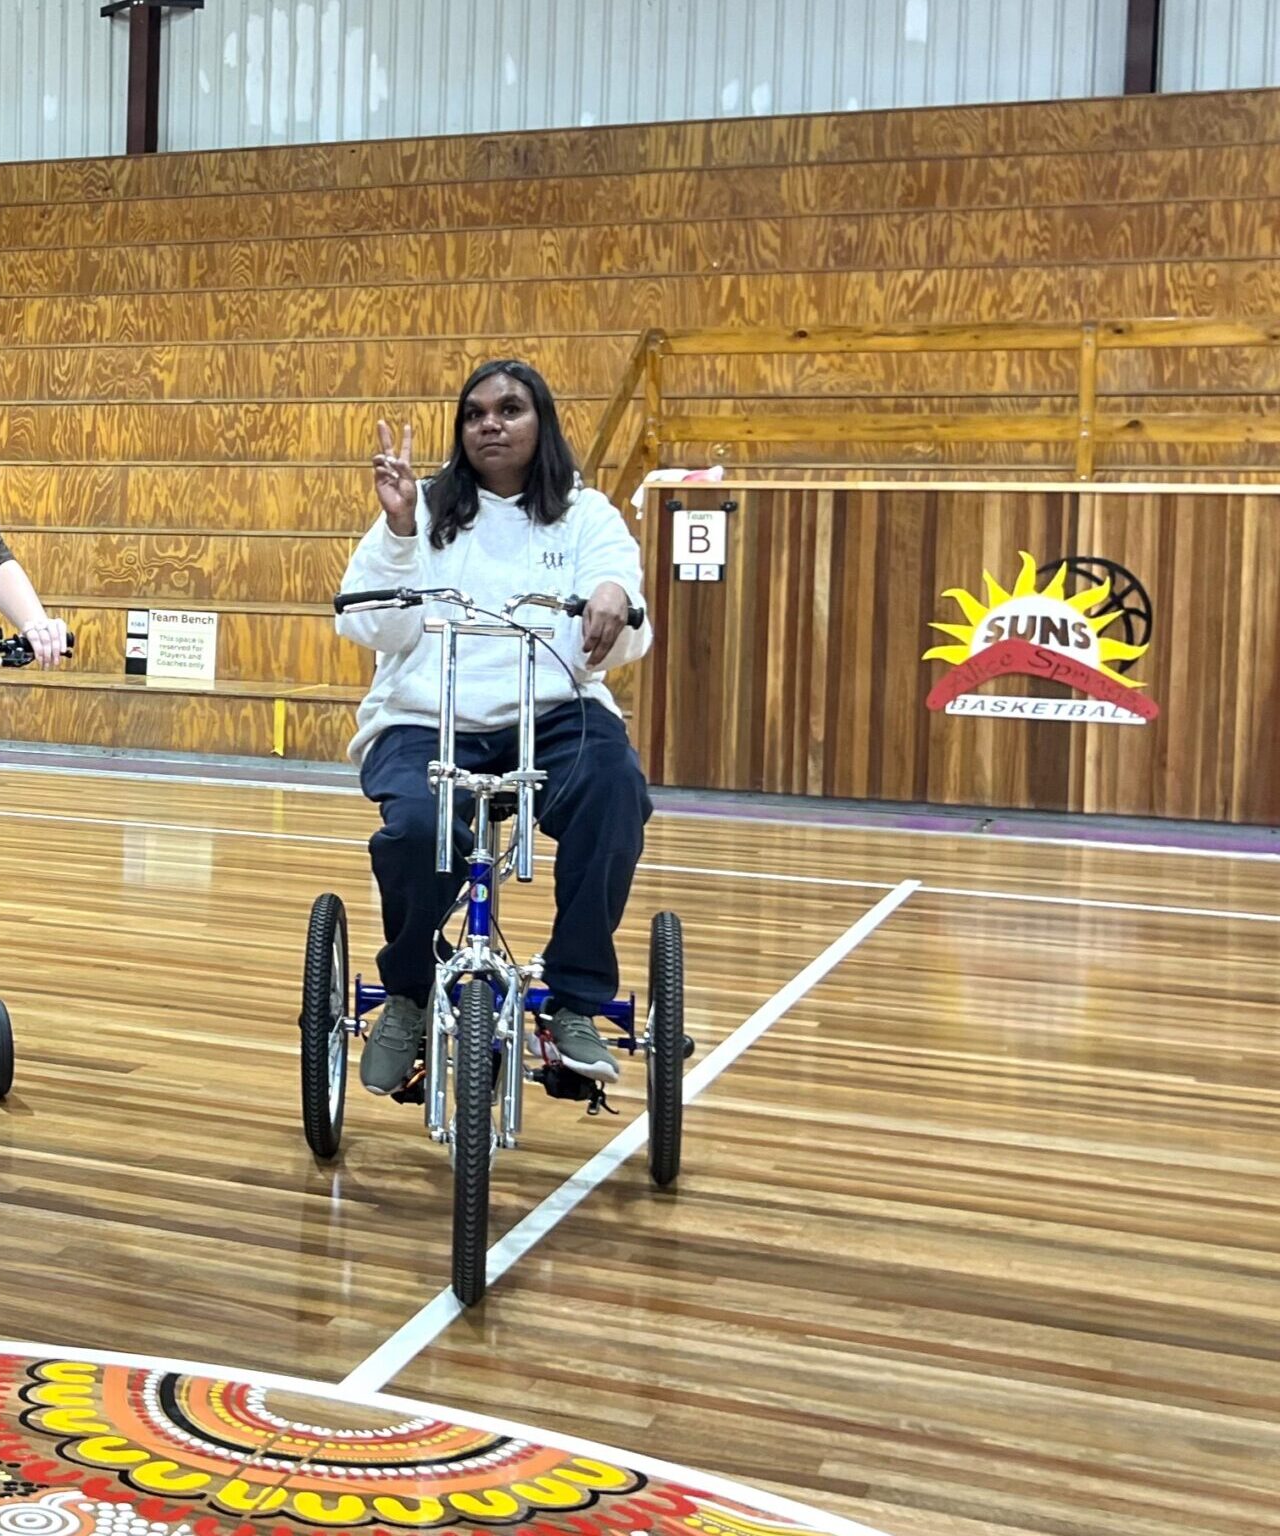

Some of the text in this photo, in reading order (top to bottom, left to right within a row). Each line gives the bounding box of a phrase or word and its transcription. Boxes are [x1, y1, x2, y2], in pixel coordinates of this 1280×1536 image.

[687, 511, 713, 520] Team
[689, 525, 711, 553] B
[151, 612, 214, 625] Team Bench
[982, 615, 1091, 649] SUNS
[175, 636, 196, 644] space
[159, 643, 191, 651] reserved
[160, 650, 186, 659] Players
[156, 659, 204, 670] Coaches only
